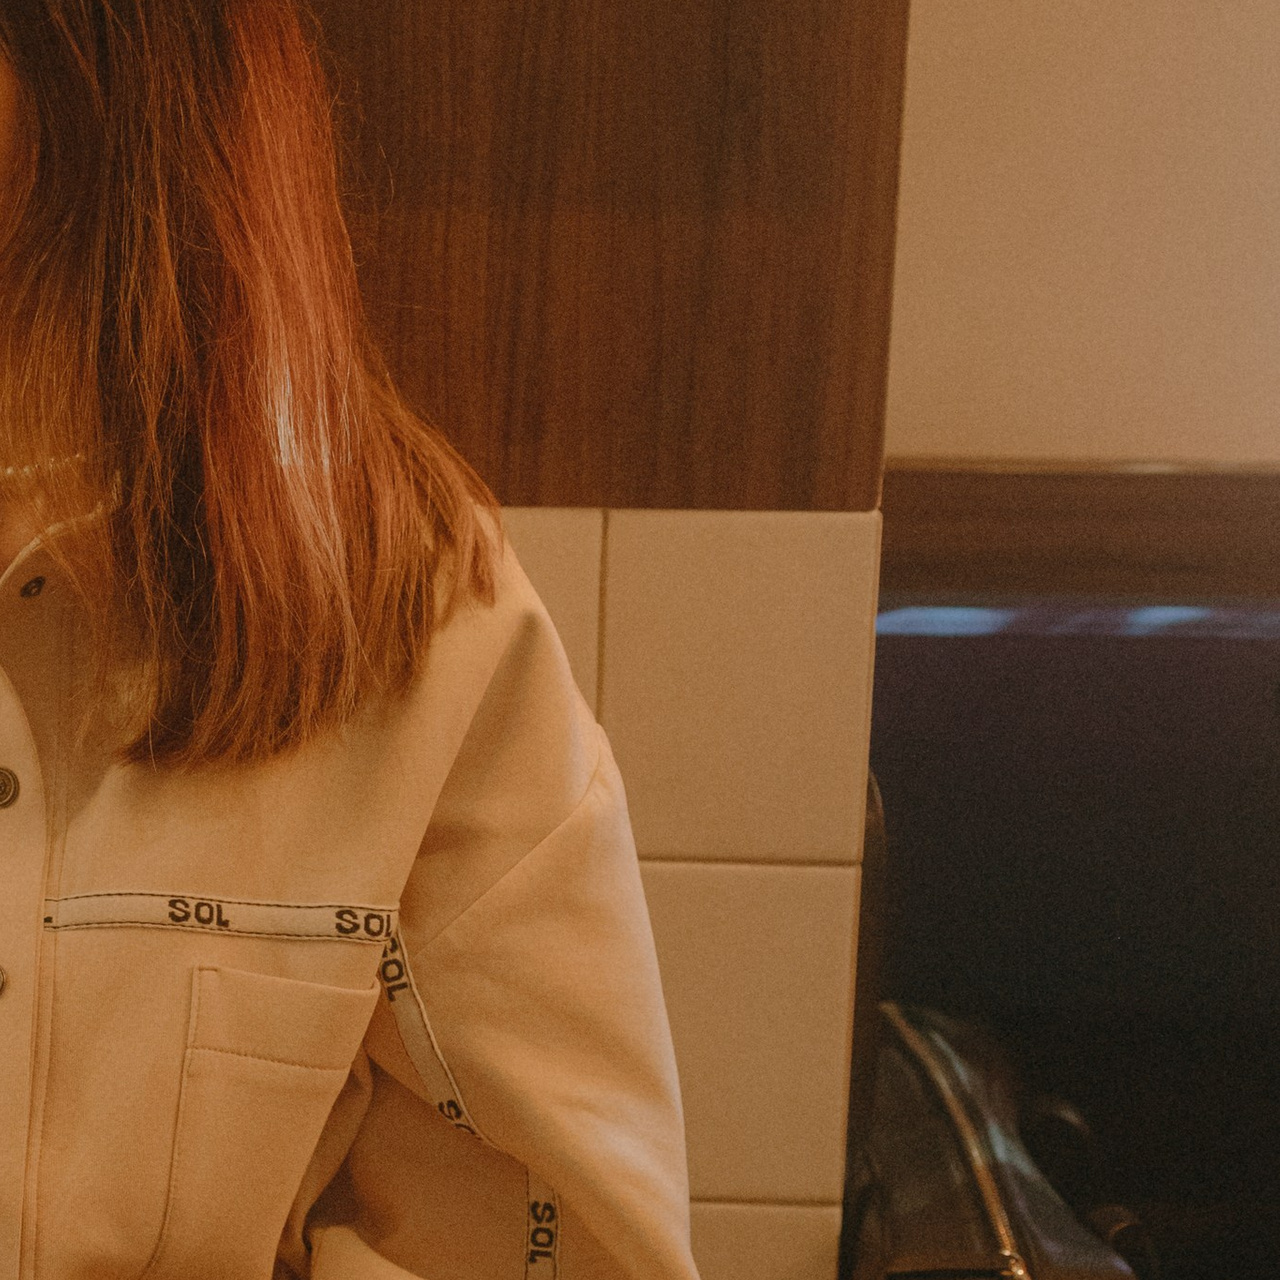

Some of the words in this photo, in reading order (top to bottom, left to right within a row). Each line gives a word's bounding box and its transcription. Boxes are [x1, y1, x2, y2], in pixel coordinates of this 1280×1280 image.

[168, 898, 229, 928] SOL
[335, 909, 392, 937] SOL
[528, 1201, 556, 1264] SOL
